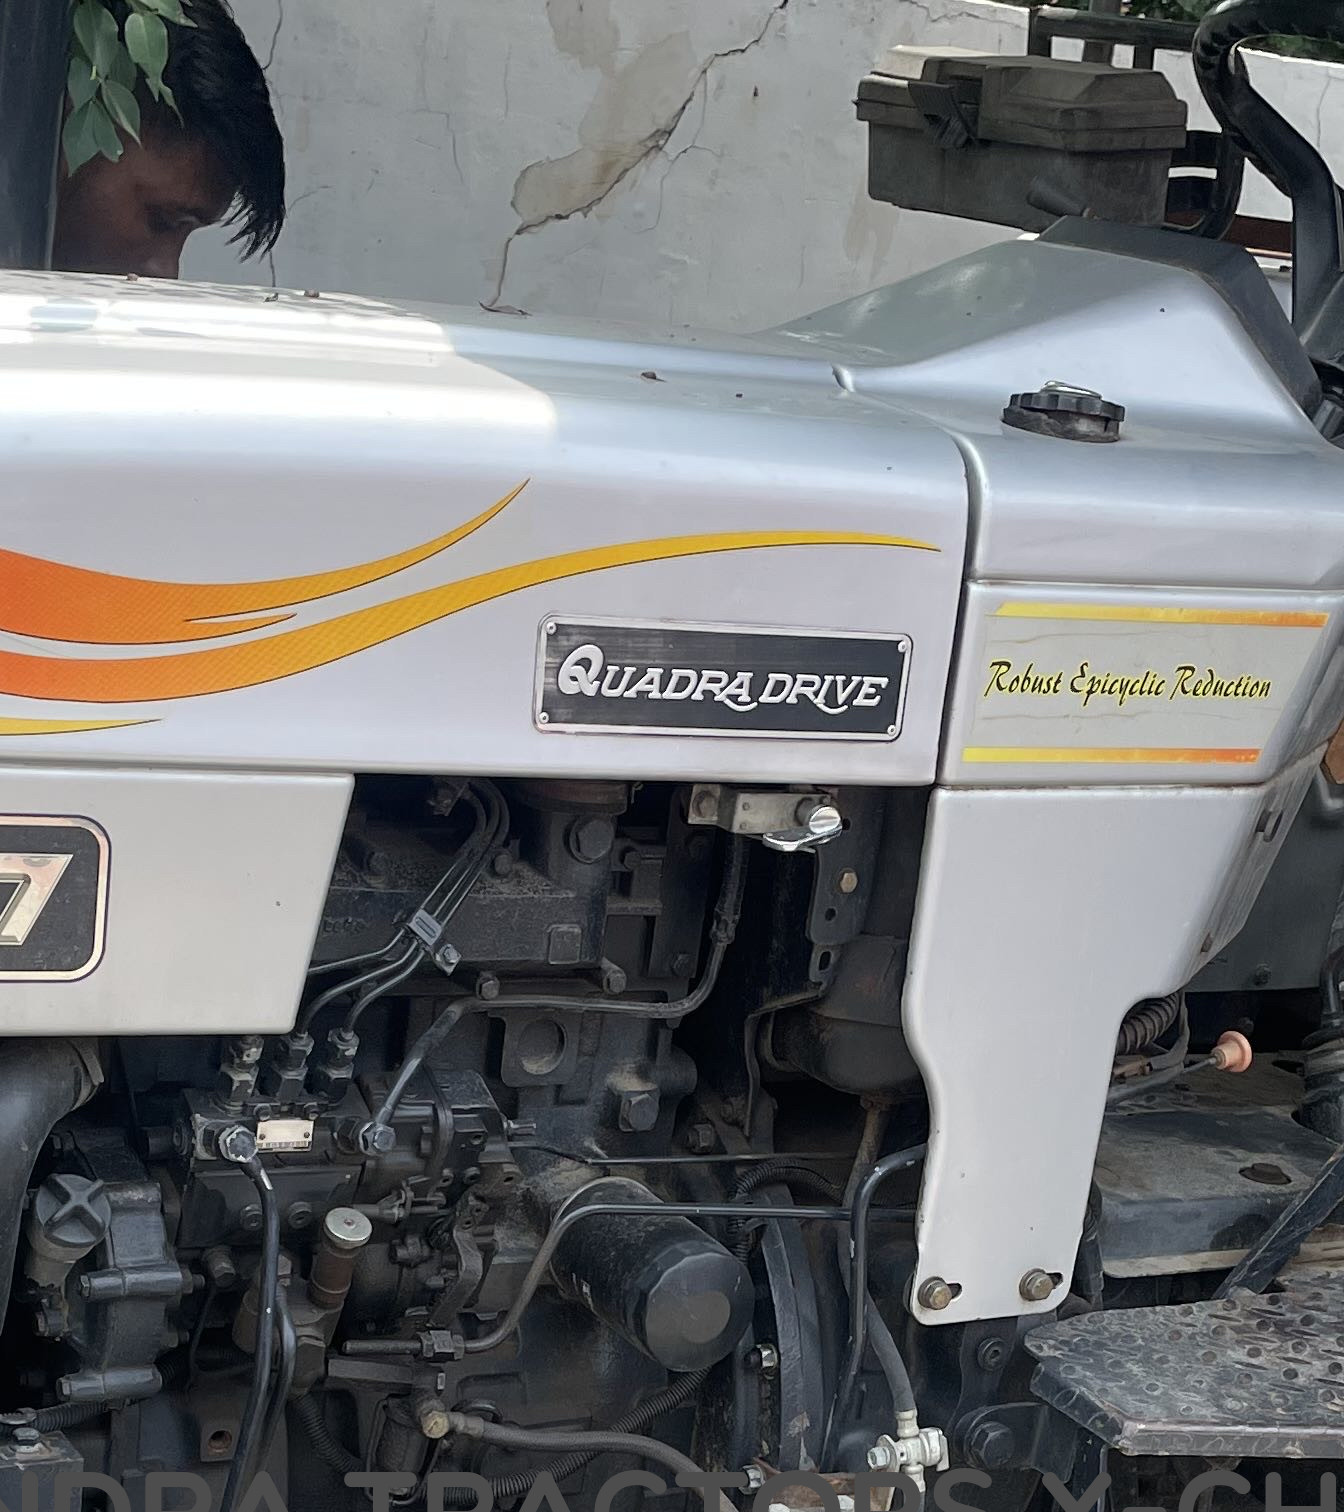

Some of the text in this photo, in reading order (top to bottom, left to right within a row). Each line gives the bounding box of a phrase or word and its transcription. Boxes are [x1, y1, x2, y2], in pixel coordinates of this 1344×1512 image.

[557, 643, 889, 715] QUADRA DRIVE
[983, 659, 1272, 707] Robust Epicyclic Reduction
